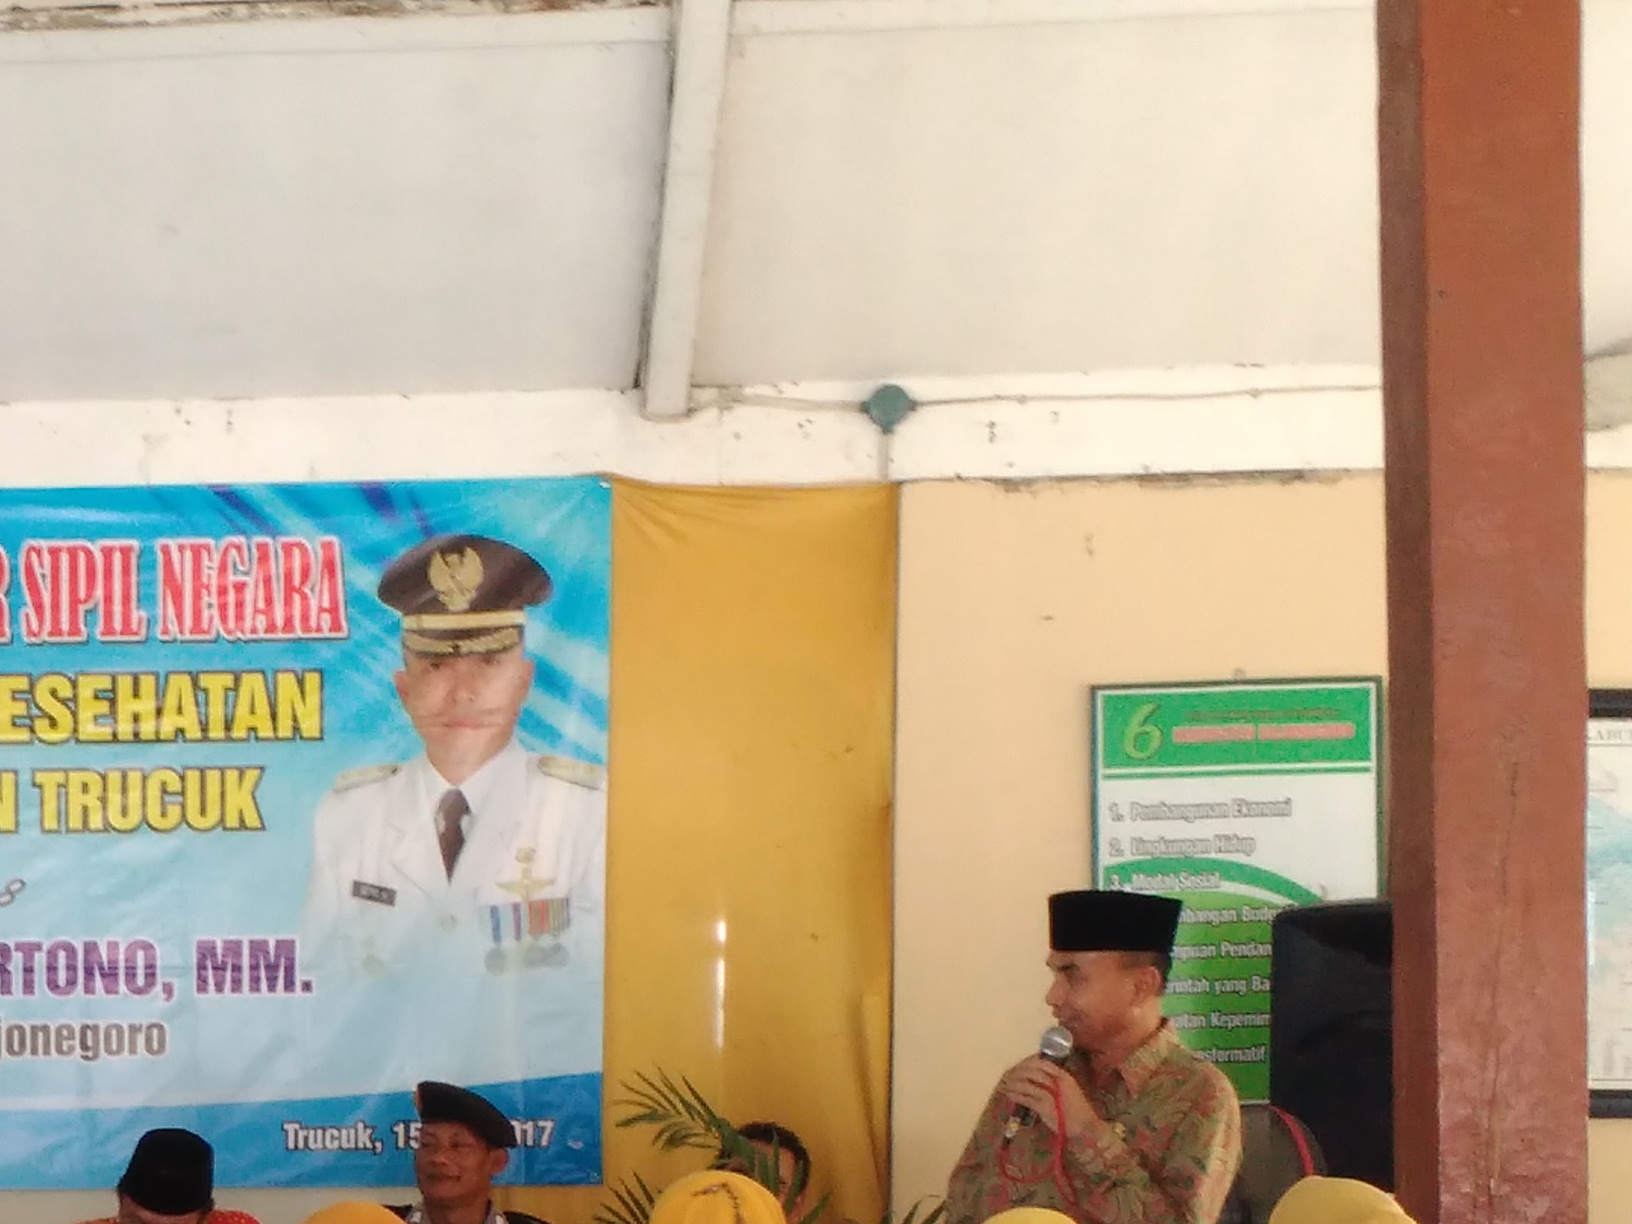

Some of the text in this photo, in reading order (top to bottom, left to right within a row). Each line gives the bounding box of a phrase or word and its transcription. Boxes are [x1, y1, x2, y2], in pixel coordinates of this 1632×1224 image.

[21, 539, 147, 643] SIPIL
[159, 536, 347, 642] NEGARA
[1125, 703, 1165, 760] 6
[32, 767, 266, 832] TRUCUK
[195, 937, 313, 996] MM.
[282, 1120, 384, 1154] Trucuk,
